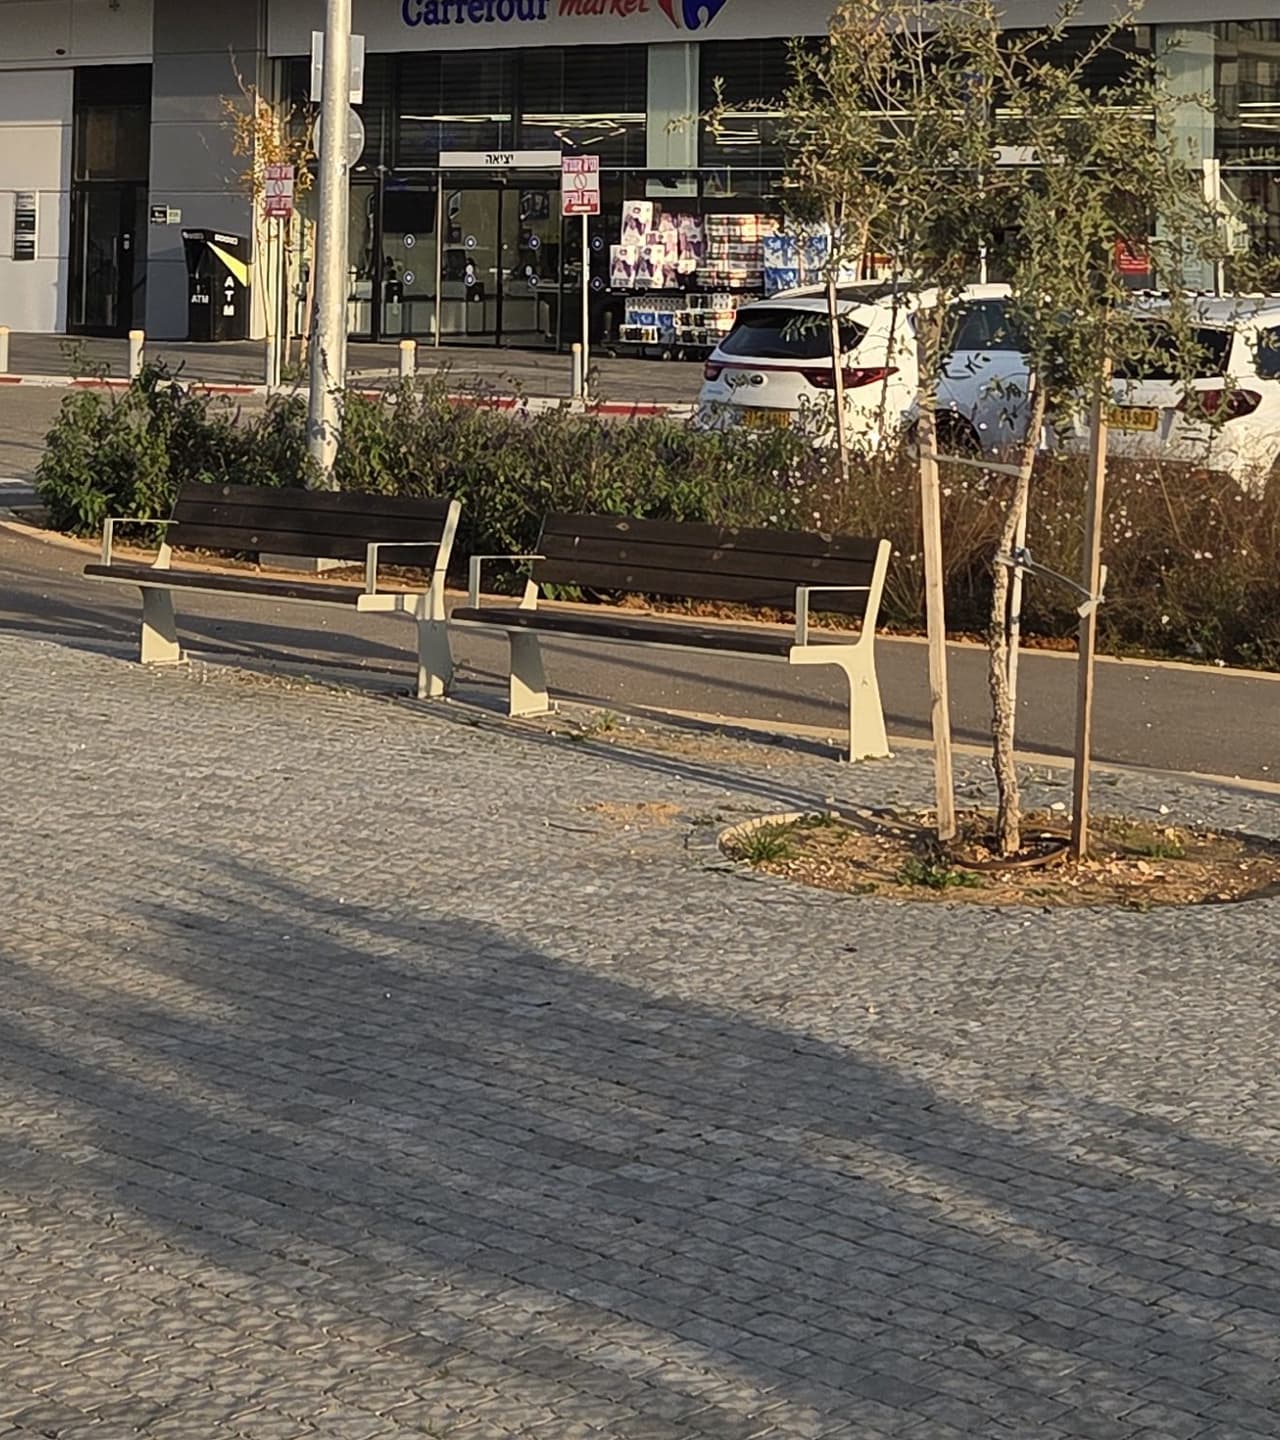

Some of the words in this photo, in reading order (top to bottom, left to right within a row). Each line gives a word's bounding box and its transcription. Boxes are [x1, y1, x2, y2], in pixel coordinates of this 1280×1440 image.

[485, 153, 514, 164] יציאה
[191, 294, 209, 304] ATM
[223, 275, 235, 316] ATM
